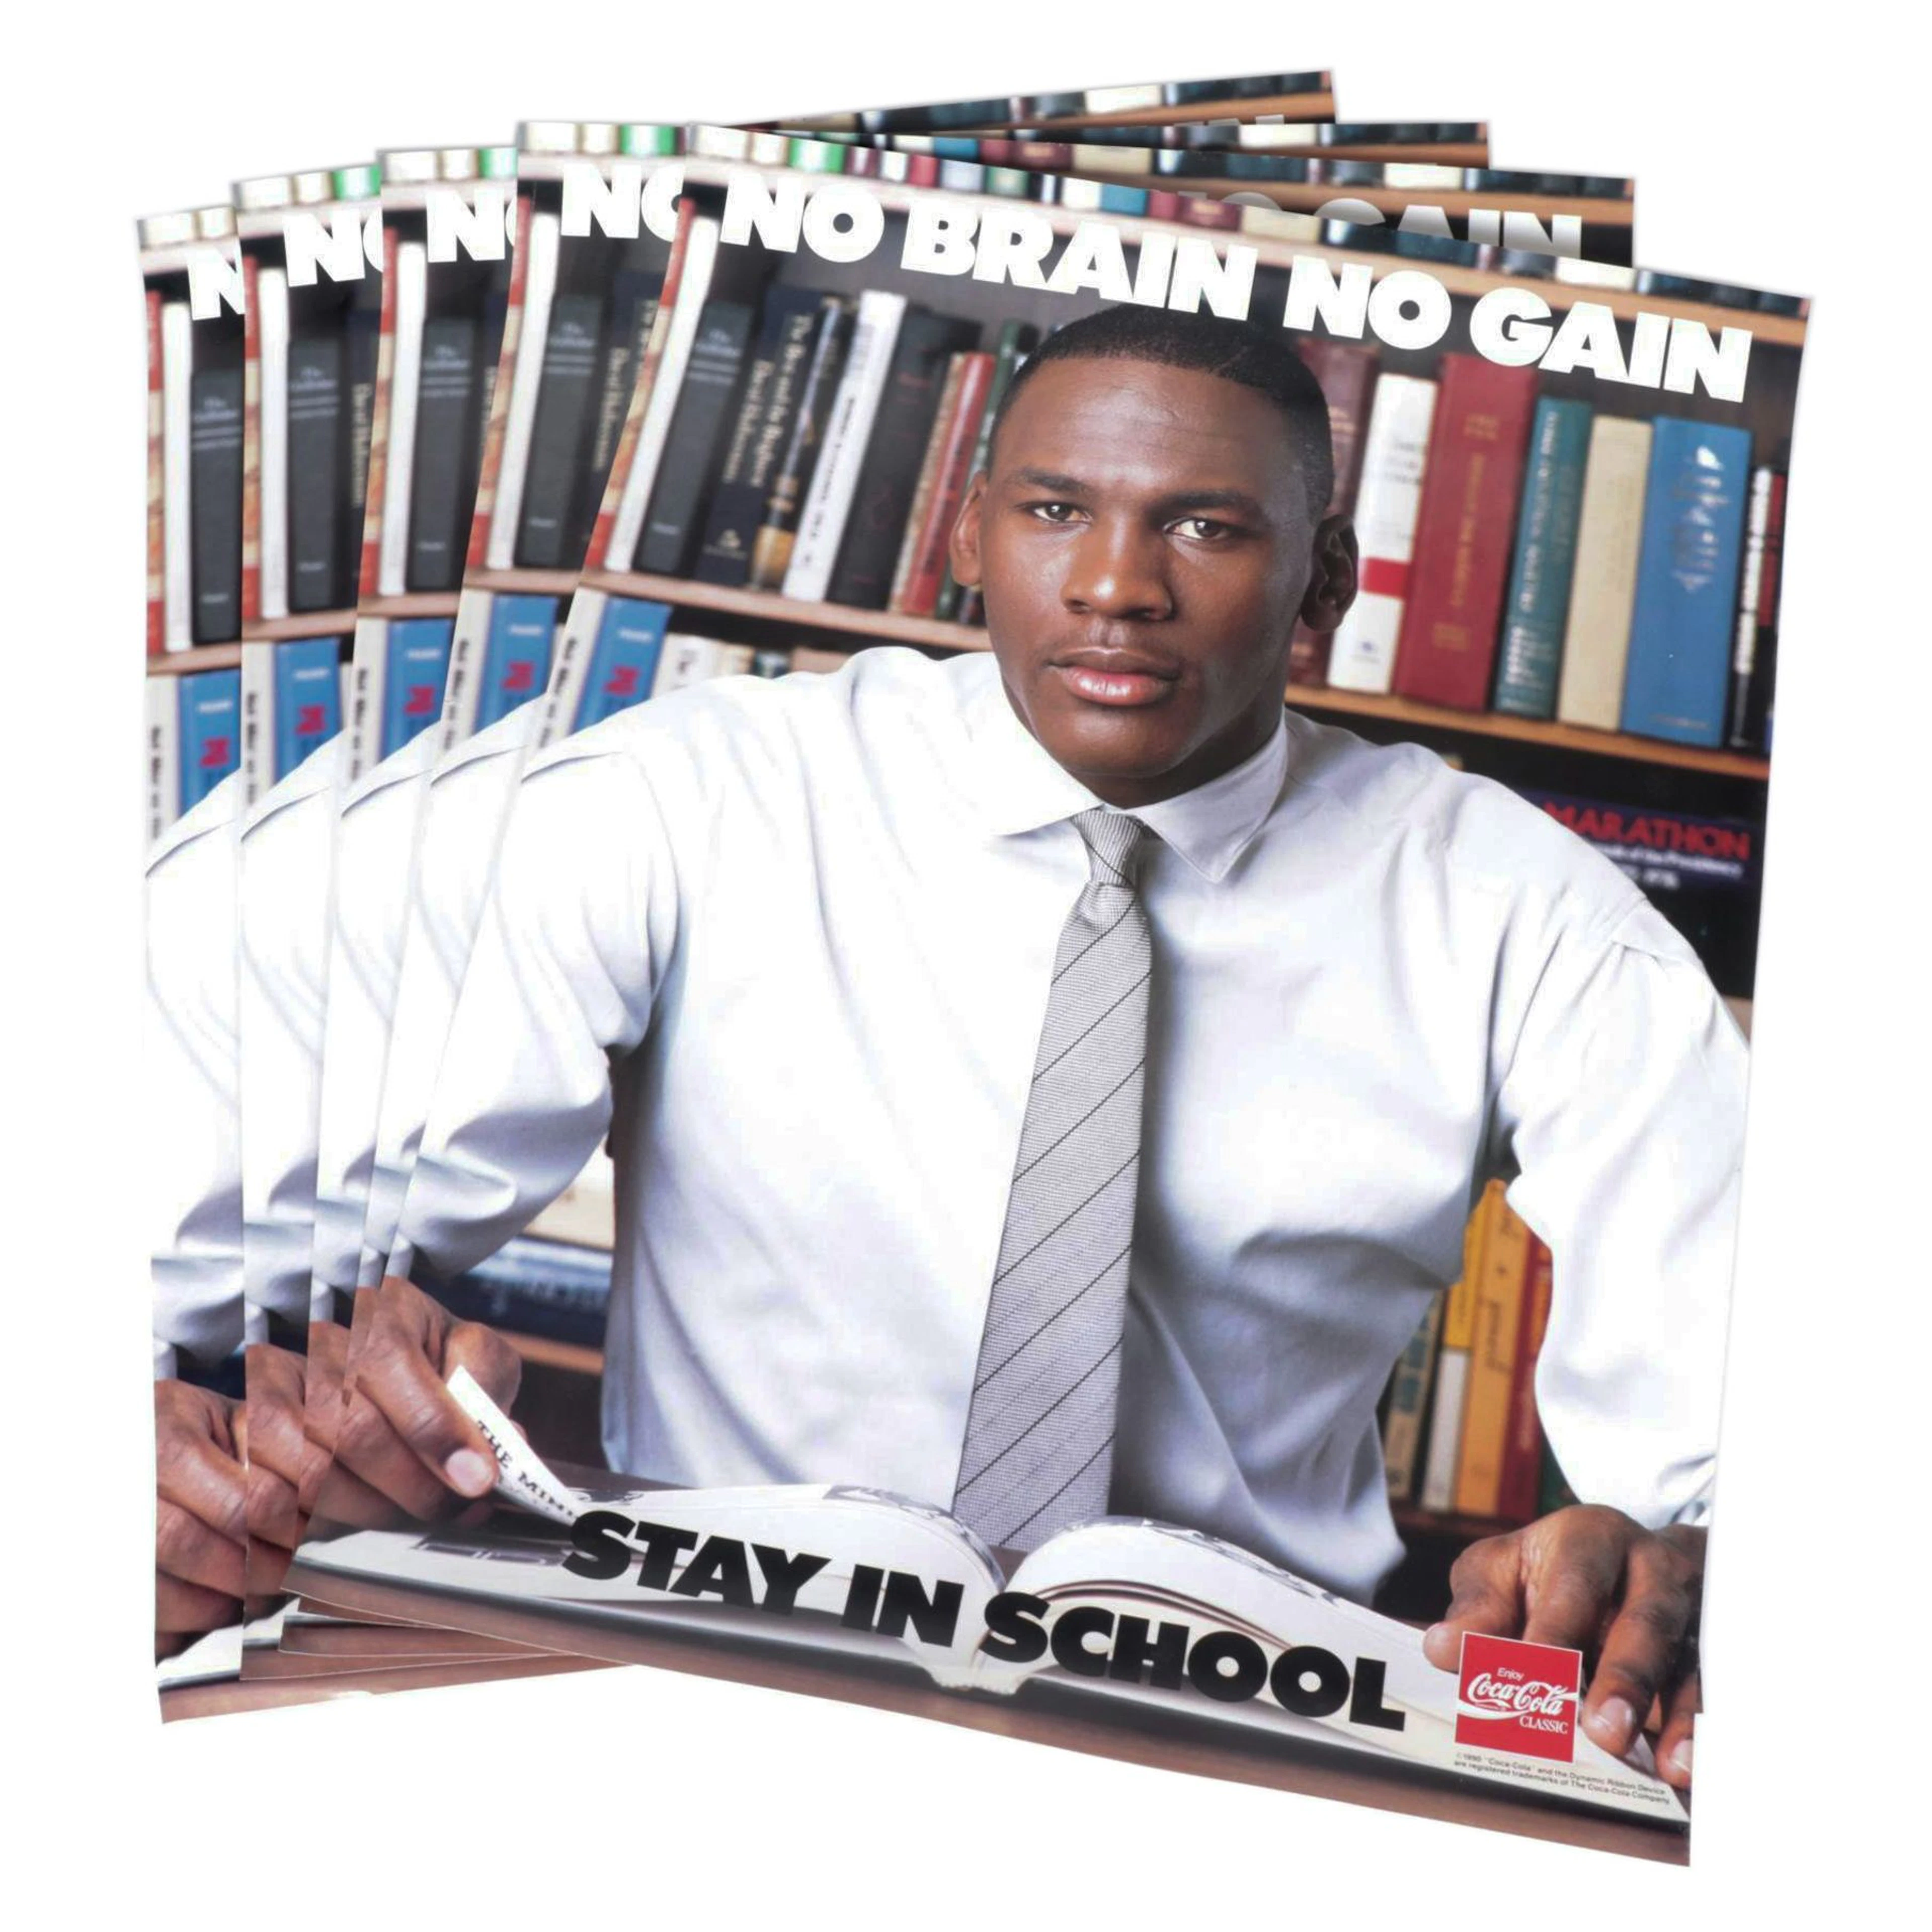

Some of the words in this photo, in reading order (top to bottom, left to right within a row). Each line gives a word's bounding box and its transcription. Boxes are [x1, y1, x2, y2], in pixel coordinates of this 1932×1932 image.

[720, 172, 884, 263] NO
[901, 201, 1258, 319] BRAIN
[1283, 257, 1452, 351] NO
[1470, 287, 1753, 403] GAIN
[1543, 802, 1750, 861] MARATHON
[478, 1420, 513, 1468] THE
[562, 1510, 832, 1617] STAY
[840, 1564, 965, 1648] IN
[979, 1591, 1406, 1732] SCHOOL
[1467, 1672, 1569, 1716] Coca-Cola
[1497, 1667, 1525, 1681] Enjoy
[1519, 1715, 1569, 1735] CLASSIC
